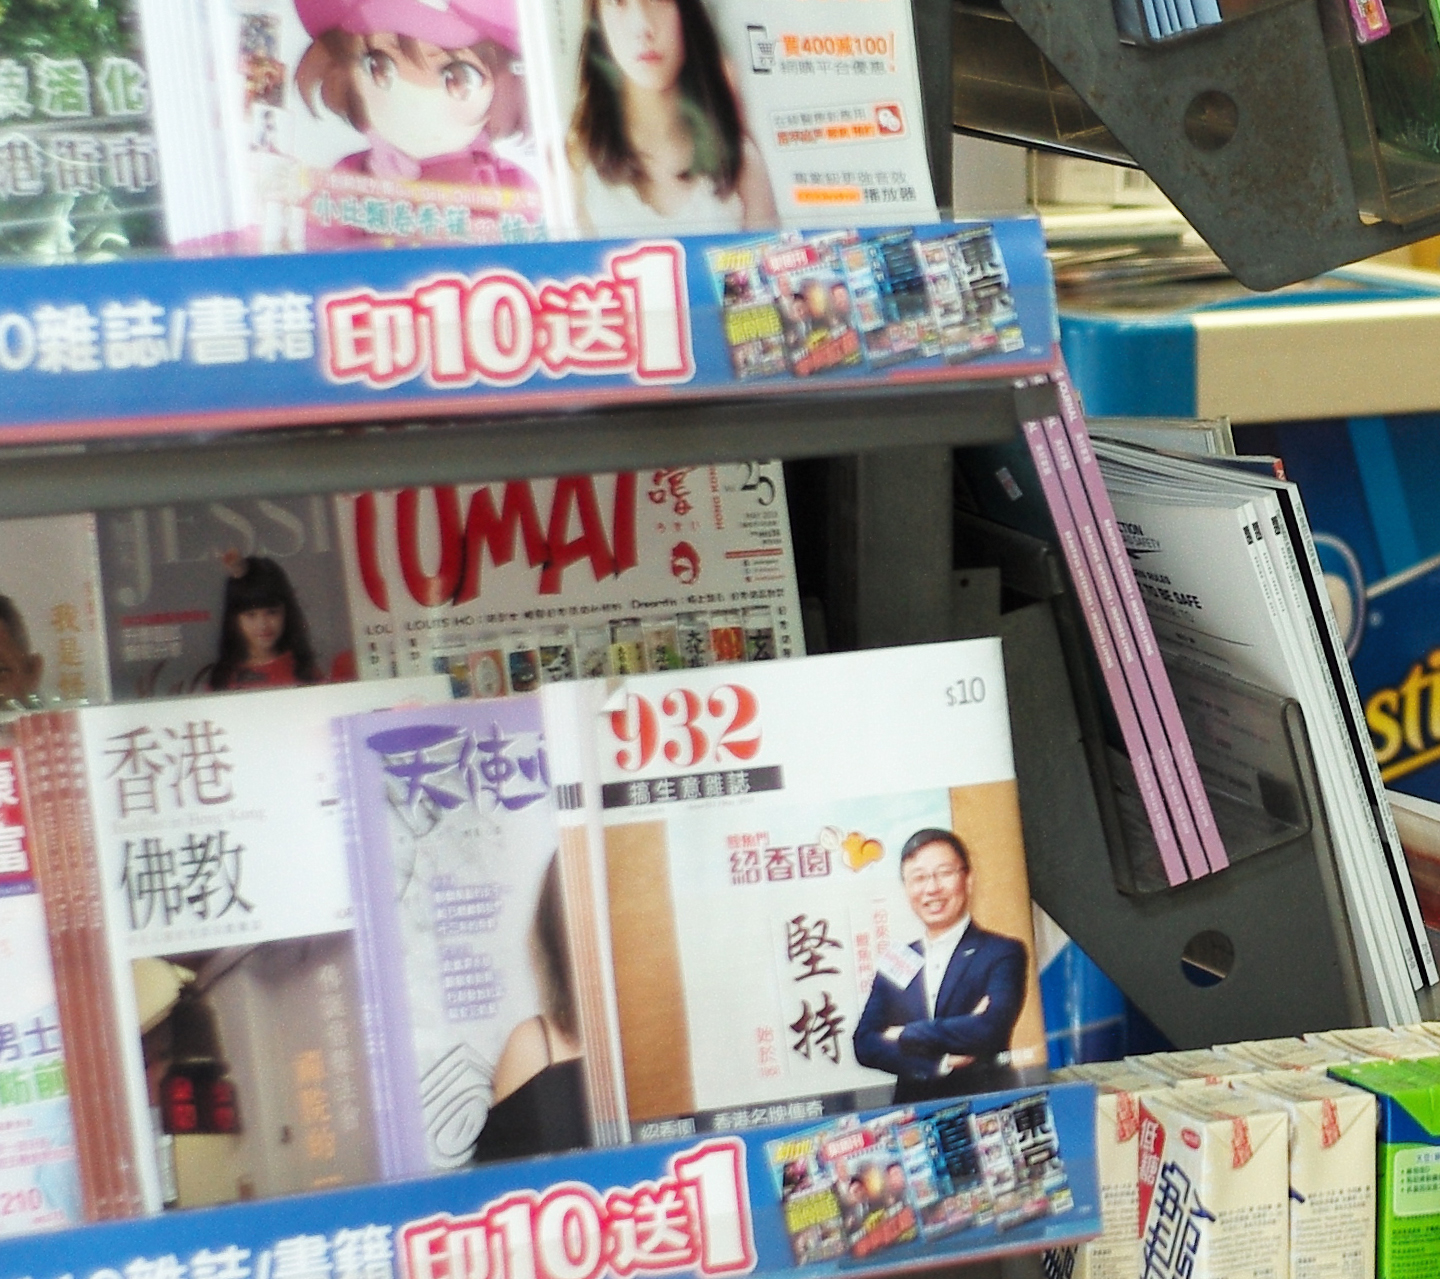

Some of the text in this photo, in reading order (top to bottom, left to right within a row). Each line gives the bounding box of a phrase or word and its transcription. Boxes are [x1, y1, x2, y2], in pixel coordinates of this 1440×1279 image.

[1174, 591, 1203, 610] SAFE
[945, 675, 987, 708] $10
[610, 682, 764, 772] 932
[103, 719, 234, 819] 香港
[627, 770, 751, 805] 搞生意雜誌
[119, 829, 255, 931] 佛教
[730, 843, 833, 886] 紹香園
[786, 913, 847, 1066] 堅持
[713, 1099, 825, 1131] 香港名牌傳奇
[1139, 1114, 1161, 1186] 低糖
